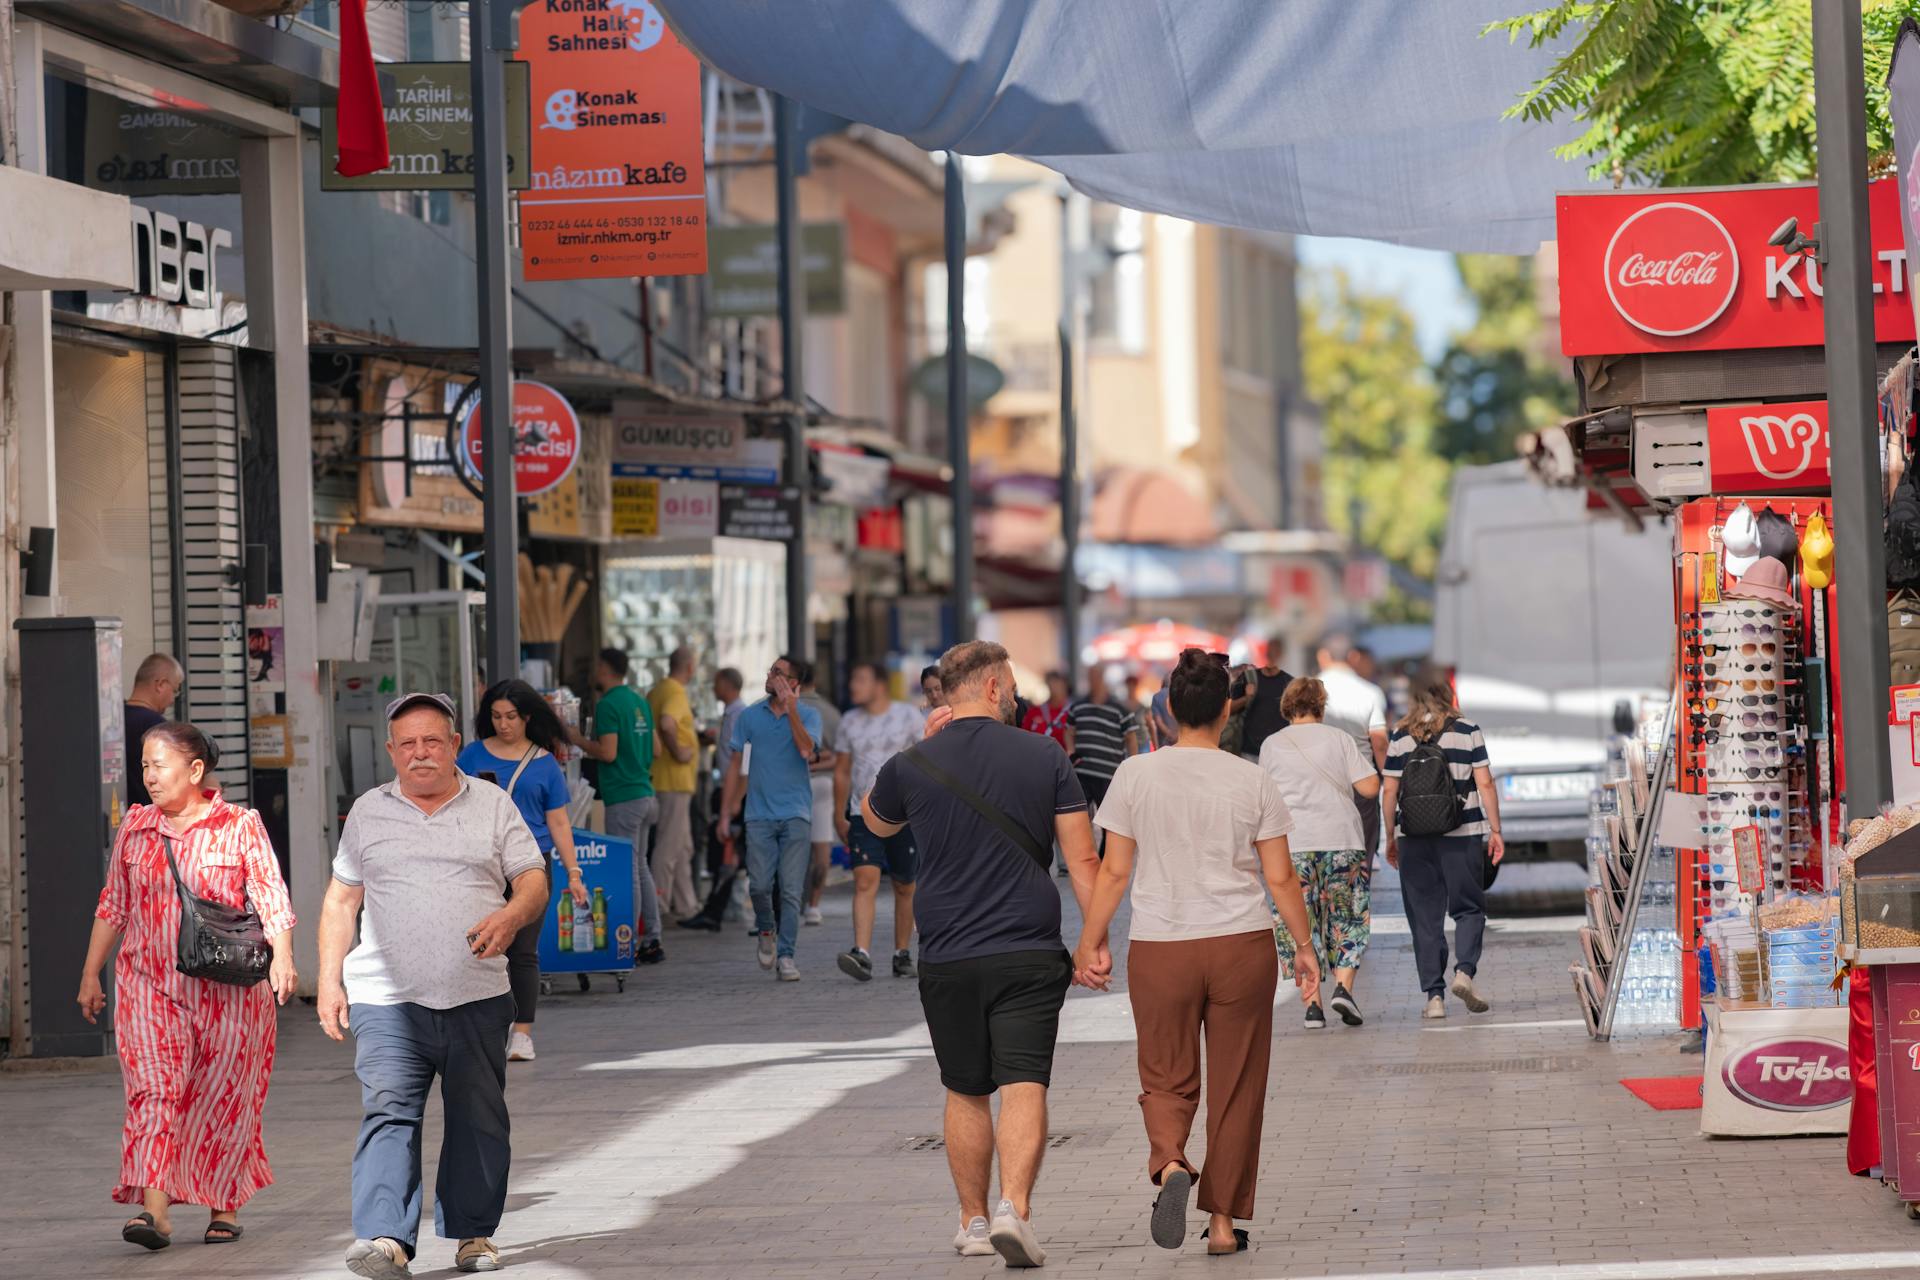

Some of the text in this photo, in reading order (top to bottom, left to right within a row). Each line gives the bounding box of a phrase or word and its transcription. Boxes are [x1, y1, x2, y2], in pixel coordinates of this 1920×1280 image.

[546, 0, 609, 12] Konak
[583, 15, 629, 32] Halk
[548, 33, 627, 51] Sahnesi
[397, 85, 452, 103] TARİHİ
[576, 89, 638, 107] Konak
[532, 161, 688, 190] nâzımkafe
[528, 220, 554, 231] 0232
[558, 219, 571, 229] 46
[573, 218, 593, 229] 444
[596, 217, 609, 228] 46
[617, 216, 644, 227] 0530
[648, 216, 666, 227] 132
[671, 215, 682, 226] 18
[685, 215, 699, 226] 40
[557, 230, 672, 246] izmir.nhkm.org.tr
[1618, 251, 1723, 286] Coca-Cola
[621, 425, 733, 449] GÜMÜŞÇÜ
